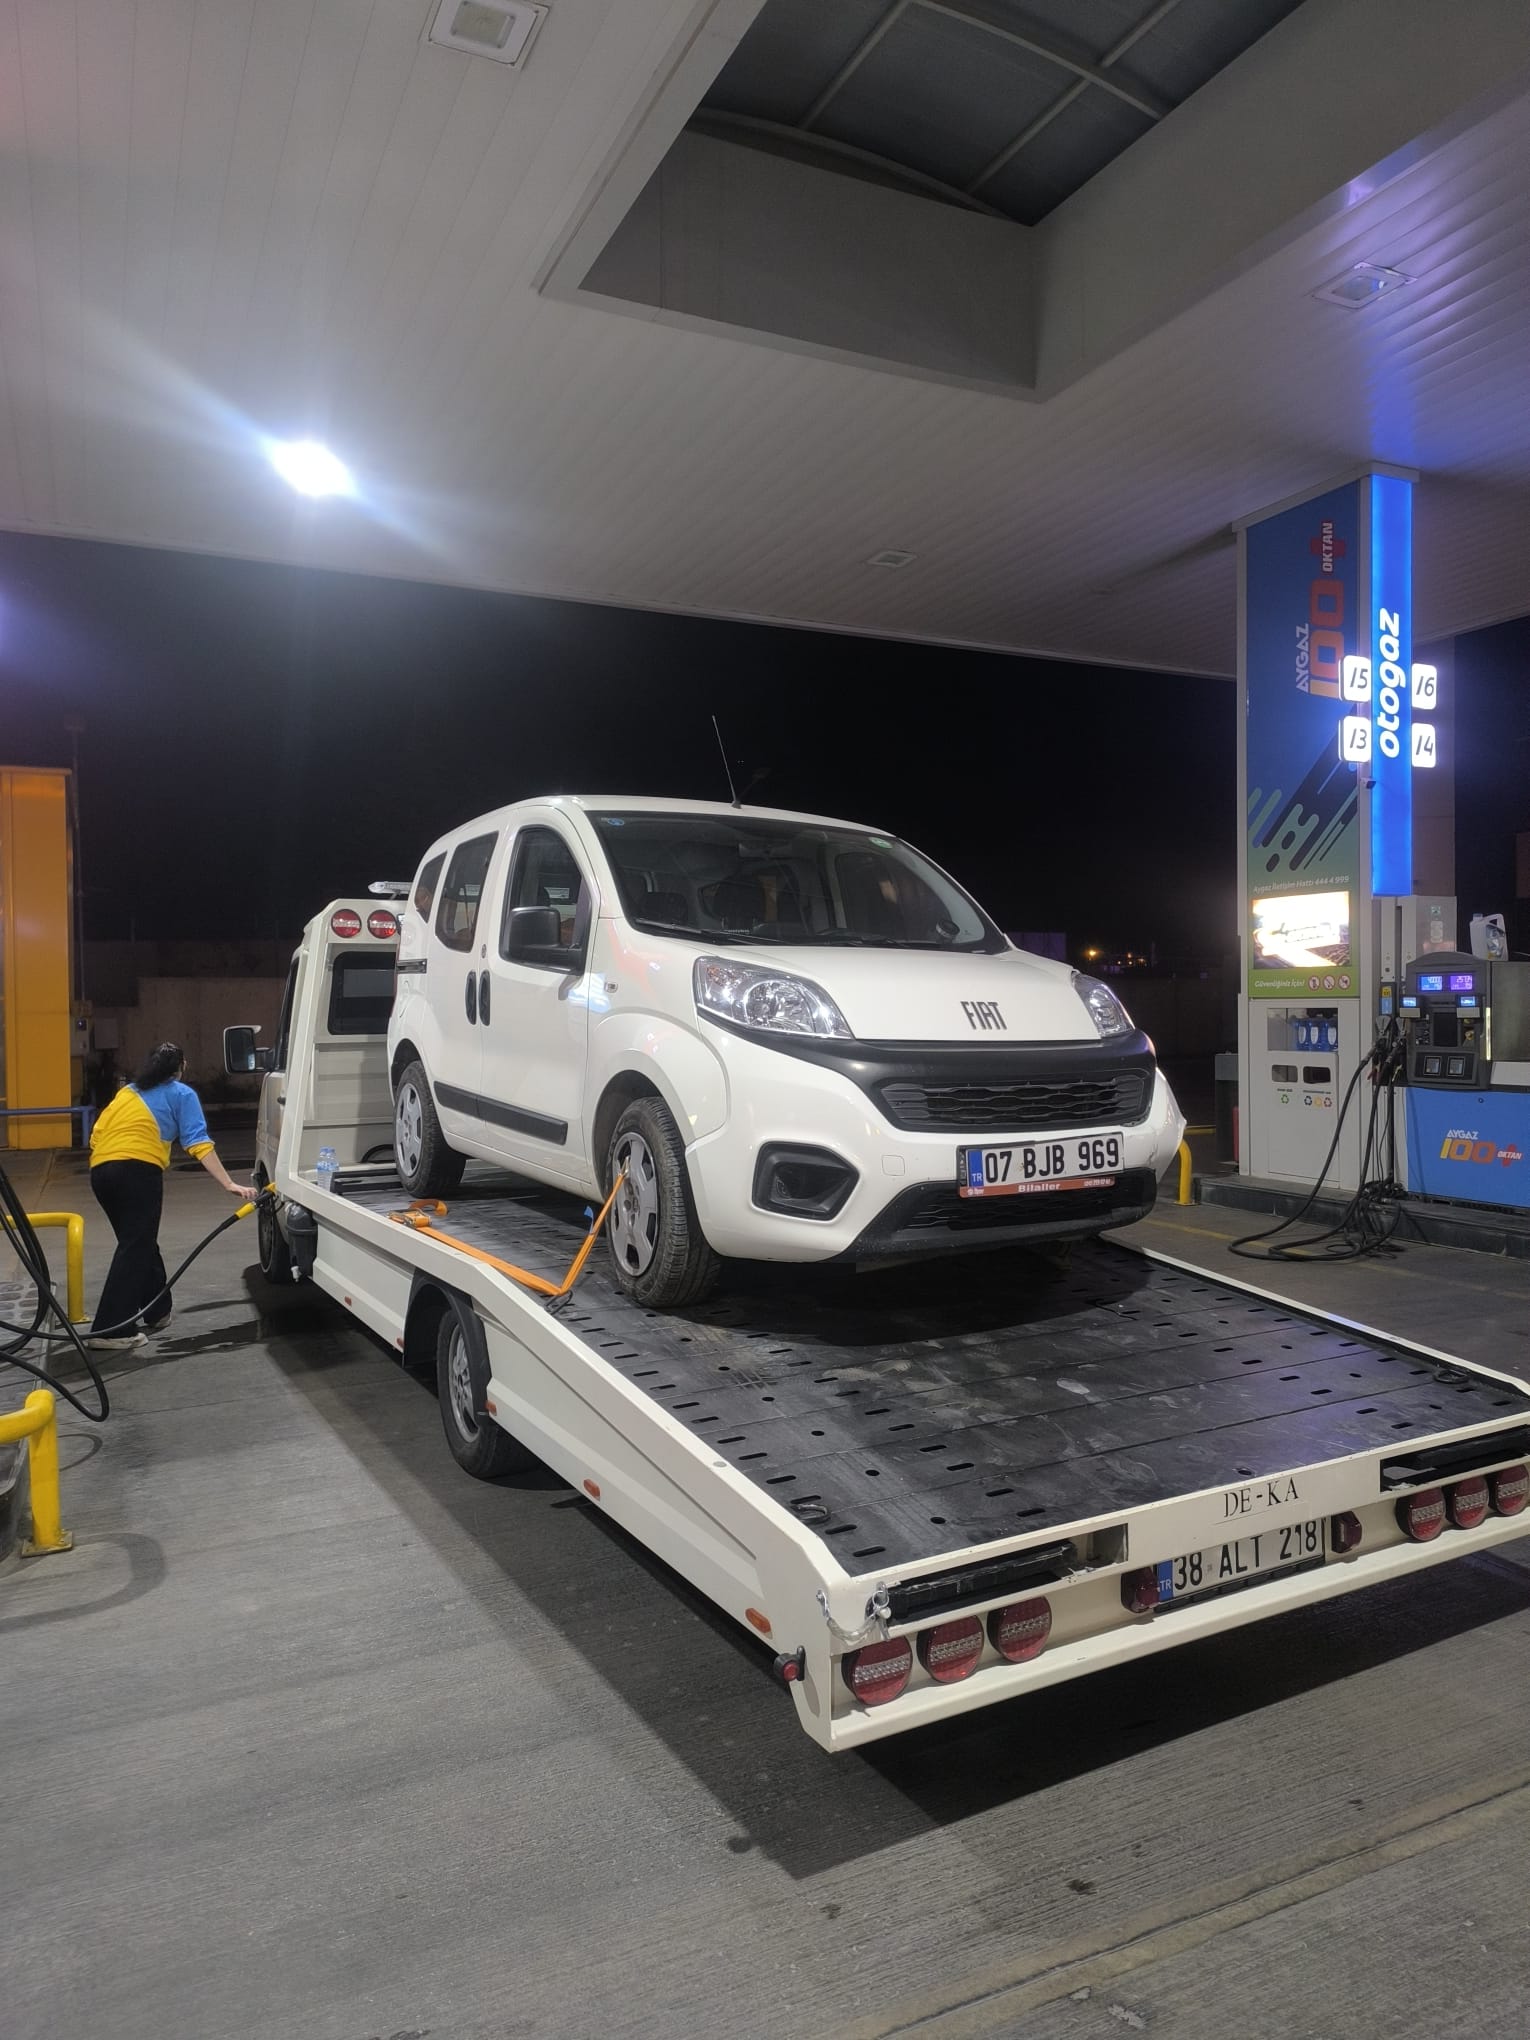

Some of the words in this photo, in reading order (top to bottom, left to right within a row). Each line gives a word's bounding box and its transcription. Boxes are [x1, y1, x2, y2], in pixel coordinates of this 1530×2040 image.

[1322, 522, 1333, 572] OKTAN
[1296, 623, 1309, 693] AYGAZ
[1349, 667, 1368, 689] 15
[1377, 608, 1406, 758] otogaz
[1416, 676, 1435, 697] 16
[1349, 728, 1368, 750] 13
[1416, 735, 1434, 756] 14
[961, 1001, 1007, 1030] FIAT
[1446, 1129, 1479, 1140] AYGAZ
[972, 1173, 983, 1182] TR
[984, 1151, 1012, 1184] 07
[1023, 1144, 1065, 1179] BJB
[1078, 1138, 1119, 1171] 969
[1223, 1477, 1299, 1518] DE-KA
[1160, 1578, 1172, 1591] TR
[1174, 1551, 1203, 1590] 38
[1219, 1534, 1264, 1578] ALT
[1279, 1521, 1317, 1561] 218
